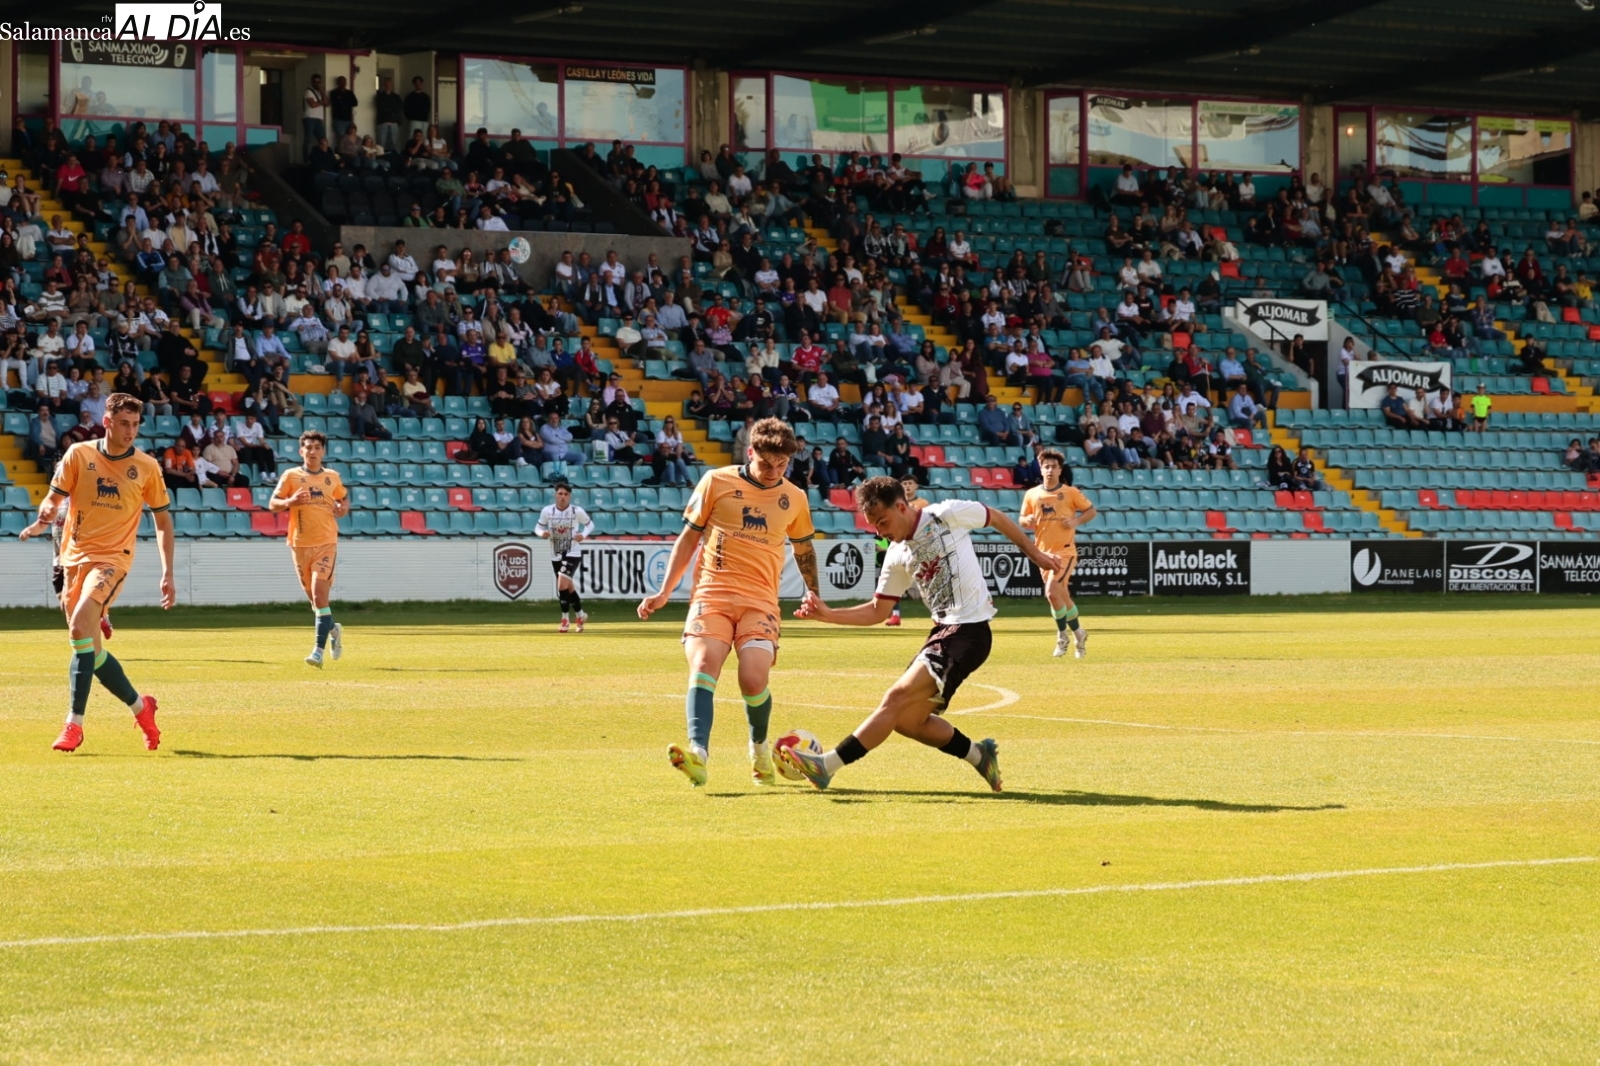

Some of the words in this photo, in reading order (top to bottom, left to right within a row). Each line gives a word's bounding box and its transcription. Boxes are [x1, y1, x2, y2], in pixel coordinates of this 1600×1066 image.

[111, 53, 155, 66] TELECOM
[566, 67, 600, 79] CASTILLA
[637, 72, 654, 82] VIDA
[1096, 97, 1126, 109] ALJOMAR
[1257, 305, 1308, 324] ALJOMAR
[1372, 369, 1430, 389] ALJOMAR
[732, 531, 769, 545] plenitude
[1095, 545, 1129, 559] grupo
[509, 556, 527, 566] UDS
[1076, 558, 1128, 568] MPRESARIAL
[1154, 549, 1238, 570] Autolack
[1540, 552, 1600, 570] SANMÁXI
[509, 569, 527, 578] CUP
[1154, 572, 1222, 588] PINTURAS,
[1225, 572, 1248, 586] S.L.
[1384, 568, 1442, 581] PANELAIS
[1449, 568, 1534, 580] DISCOSA
[1448, 583, 1460, 591] DE
